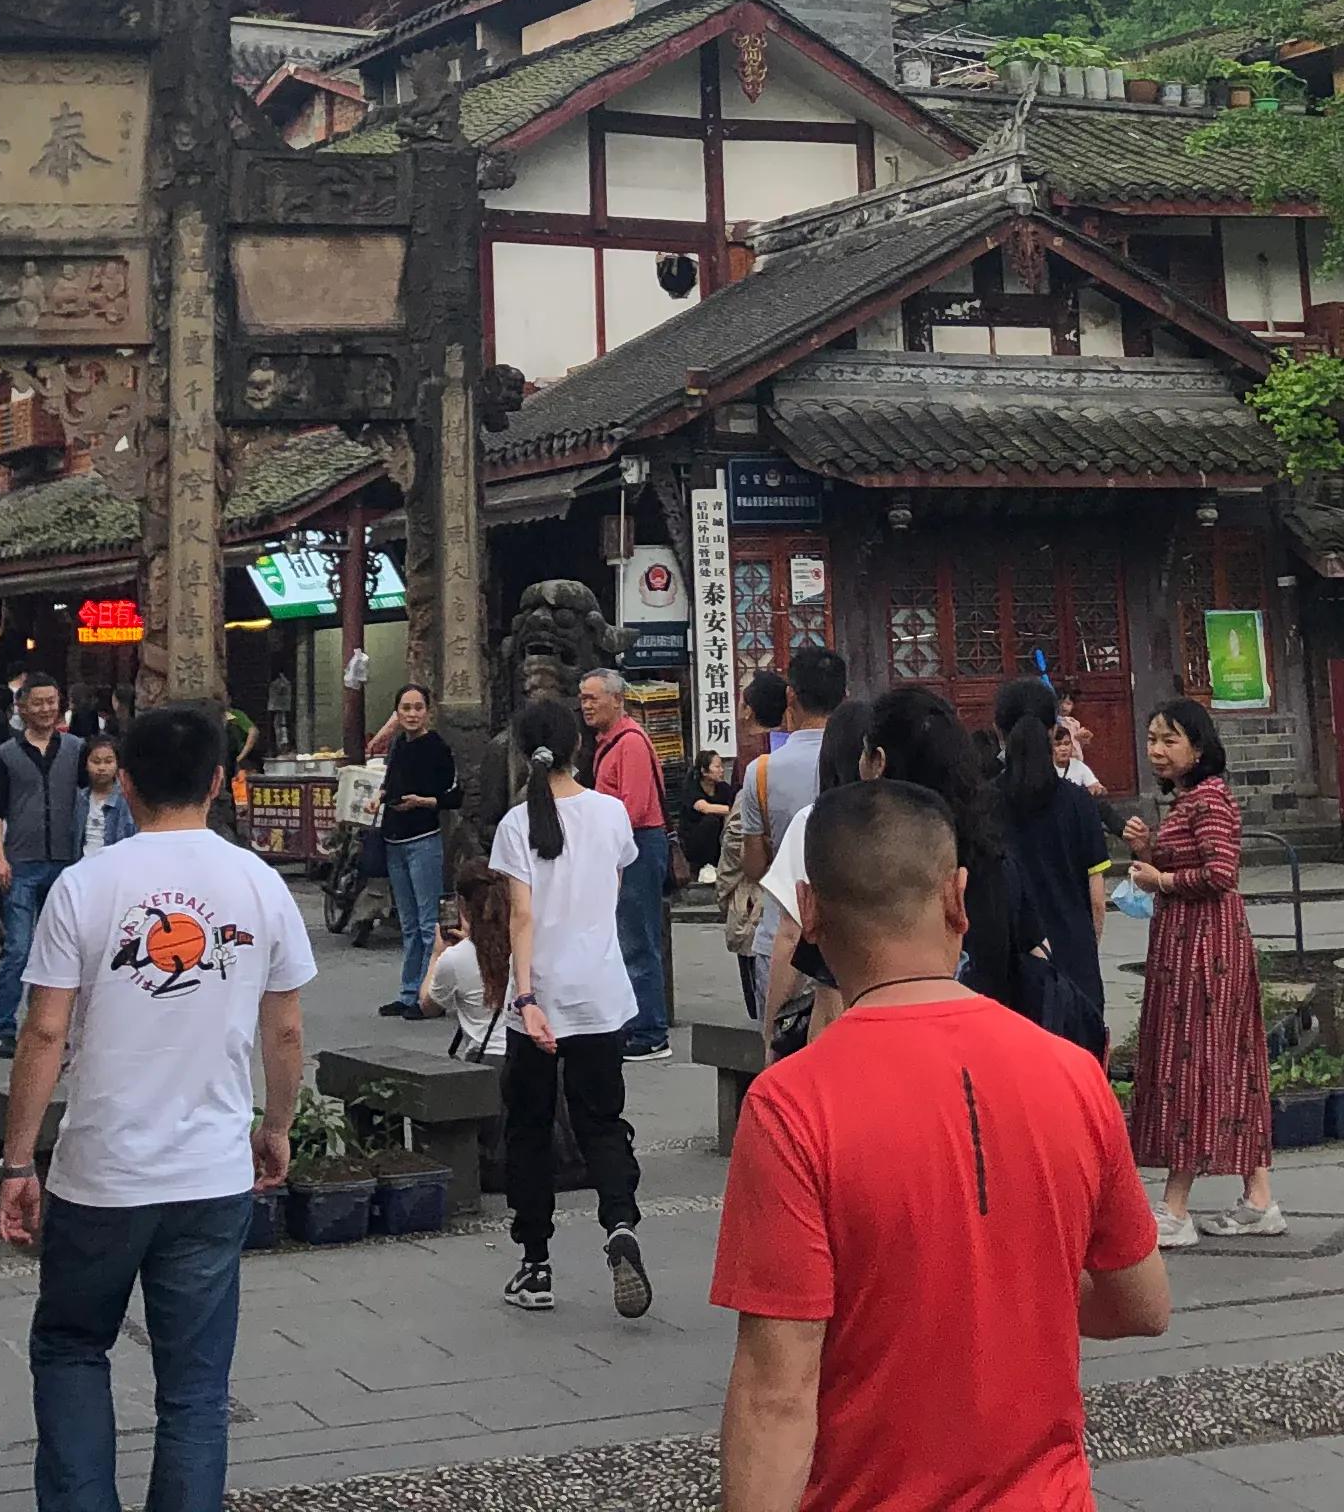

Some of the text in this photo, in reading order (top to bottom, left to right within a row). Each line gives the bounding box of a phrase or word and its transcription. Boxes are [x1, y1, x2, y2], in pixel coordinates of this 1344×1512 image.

[701, 581, 731, 744] 泰安寺管理所
[120, 892, 215, 947] BAKETBALL
